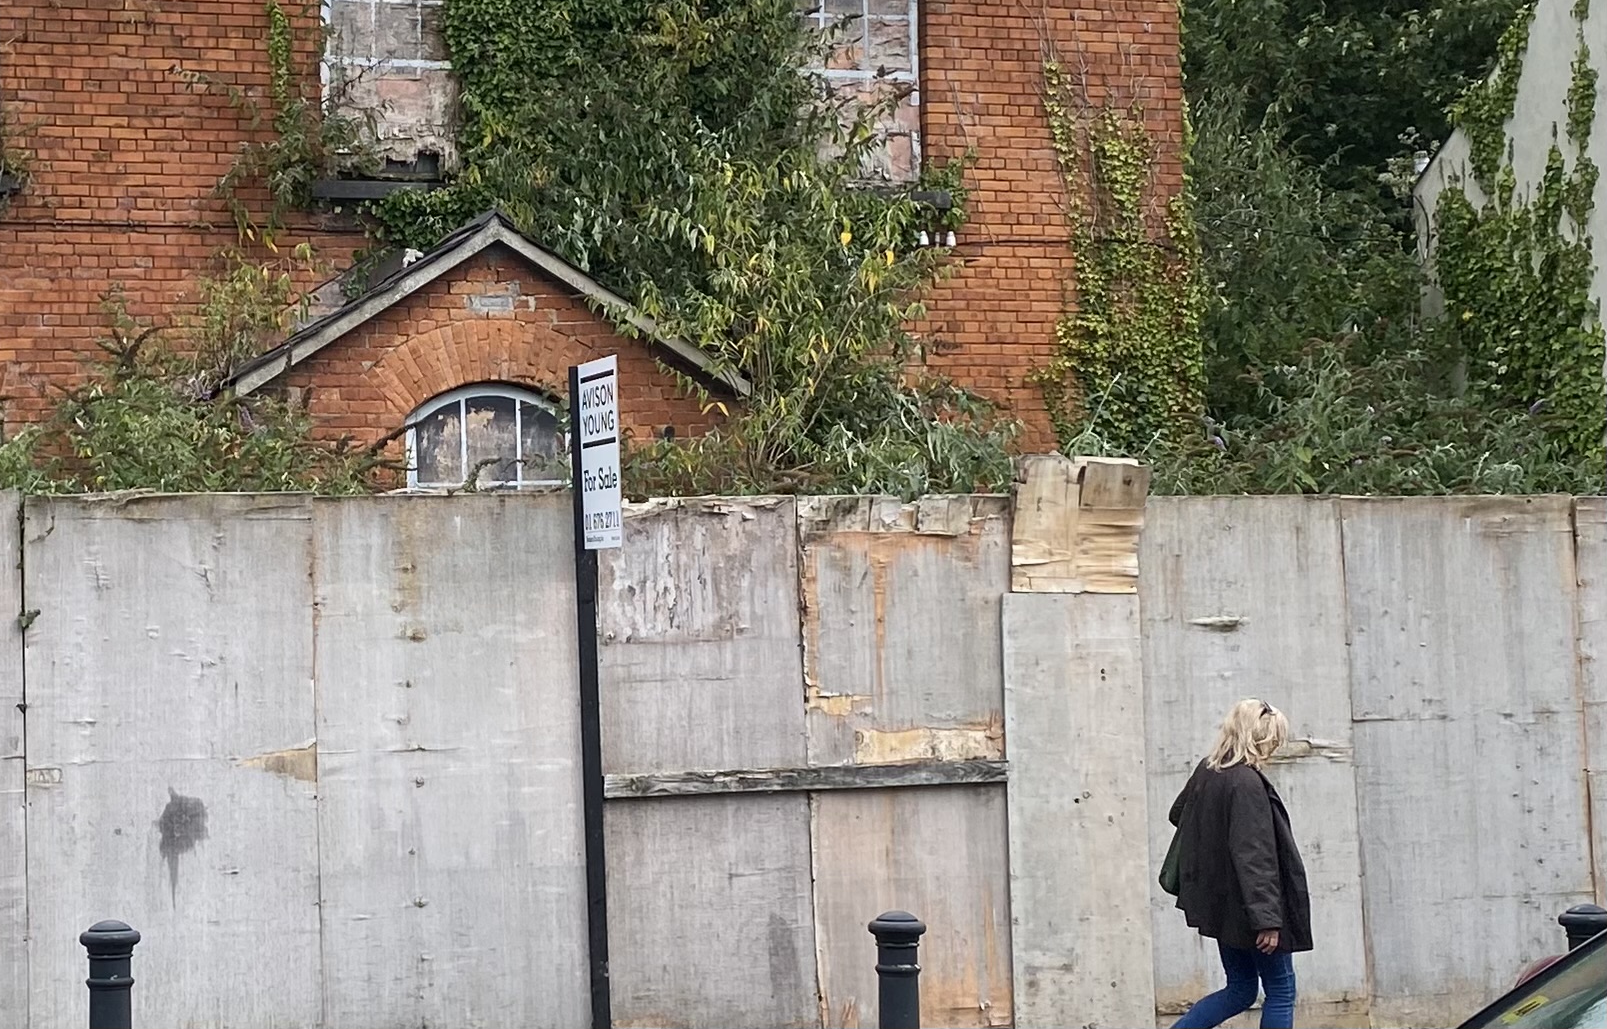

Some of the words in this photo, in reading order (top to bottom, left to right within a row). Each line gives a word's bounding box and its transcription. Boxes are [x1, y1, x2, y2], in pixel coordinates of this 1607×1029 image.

[582, 383, 614, 410] AVISON
[582, 410, 614, 436] YOUNG
[584, 469, 596, 492] For
[598, 466, 618, 490] Sale
[585, 513, 592, 530] 01
